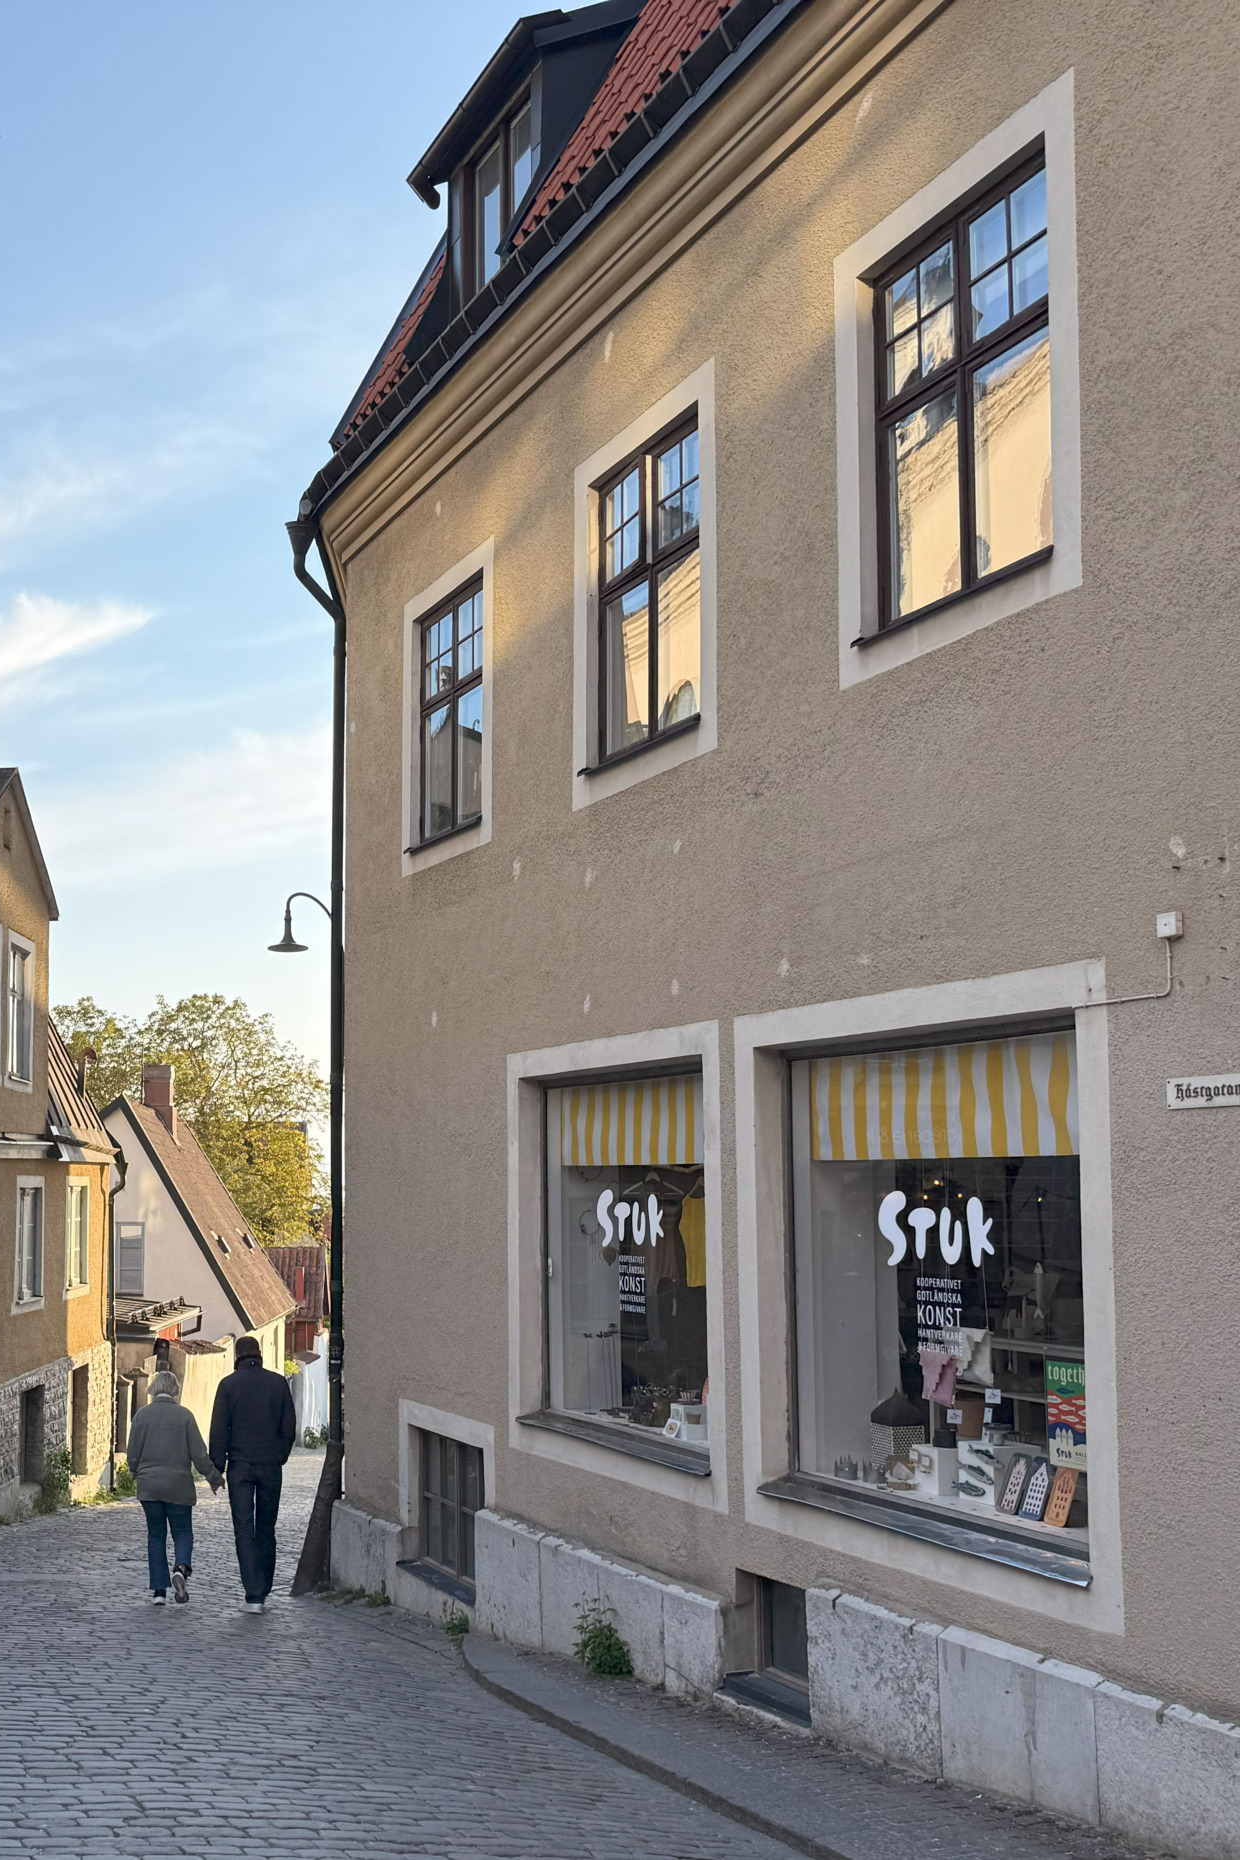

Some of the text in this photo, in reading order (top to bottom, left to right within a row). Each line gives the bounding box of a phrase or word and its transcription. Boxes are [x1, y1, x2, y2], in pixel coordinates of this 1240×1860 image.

[619, 1275, 646, 1293] KONST
[916, 1276, 962, 1290] KOOPERATIVET
[916, 1289, 962, 1304] GOTLÄNDSKA
[917, 1304, 963, 1328] KONST
[917, 1327, 963, 1342] HANTVERKARE
